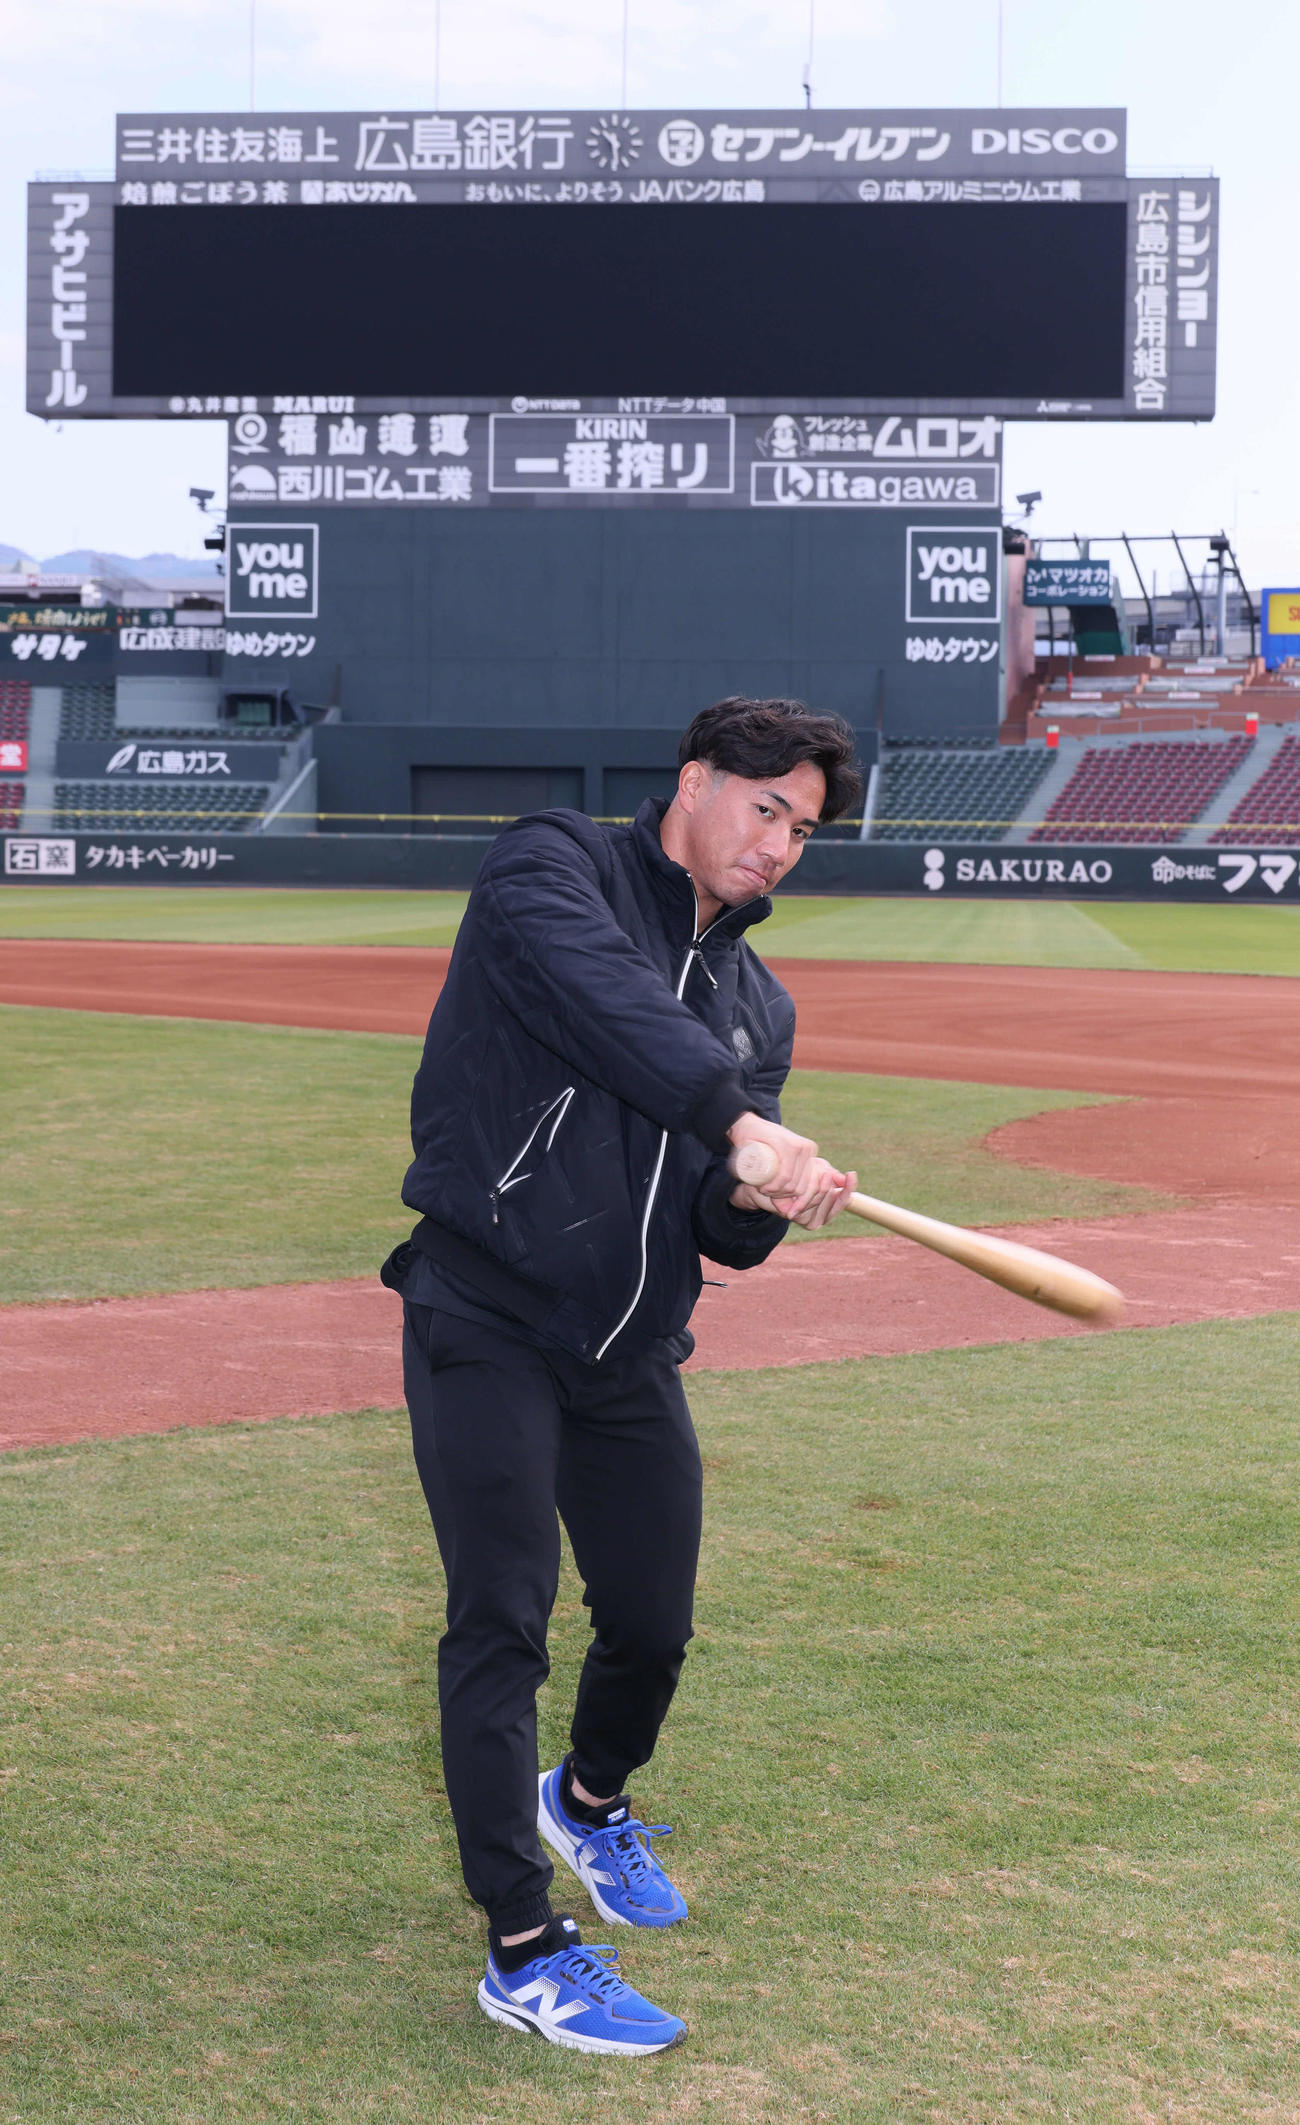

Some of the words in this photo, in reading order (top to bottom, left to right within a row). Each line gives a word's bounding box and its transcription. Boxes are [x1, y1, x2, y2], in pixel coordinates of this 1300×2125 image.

[121, 127, 339, 164] 三井住友海上
[355, 116, 574, 171] 広島銀行
[972, 128, 1118, 154] DISCO
[465, 181, 623, 202] おもいに、よりそう
[630, 179, 766, 202] JAバンク広島
[883, 180, 1082, 202] 広島アルミニウム工業
[1176, 190, 1211, 348] シシンヨー
[46, 193, 90, 408] アサヒビール
[1132, 190, 1171, 411] 広島市信用組合
[273, 396, 355, 413] MARUI
[617, 397, 727, 413] NTTデータ中国
[278, 413, 469, 456] 福山通運
[575, 418, 648, 440] KIRIN
[803, 415, 868, 432] フレッシュ
[872, 415, 1002, 457] ムロオ
[514, 440, 709, 488] 一番搾り
[277, 465, 472, 501] 西川ゴム工業
[236, 542, 305, 576] you
[917, 545, 987, 580] you
[249, 573, 308, 599] me
[1048, 567, 1108, 584] マツオカ
[930, 576, 991, 603] me
[1026, 584, 1108, 598] コーポレーション
[11, 634, 87, 661] サタケ
[226, 632, 316, 657] ゆめタウン
[905, 637, 999, 663] ゆめタウン
[137, 749, 231, 774] 広島ガス
[85, 845, 235, 870] タカキベーカリー
[956, 858, 1113, 884] SAKURAO
[1218, 854, 1300, 894] フマ
